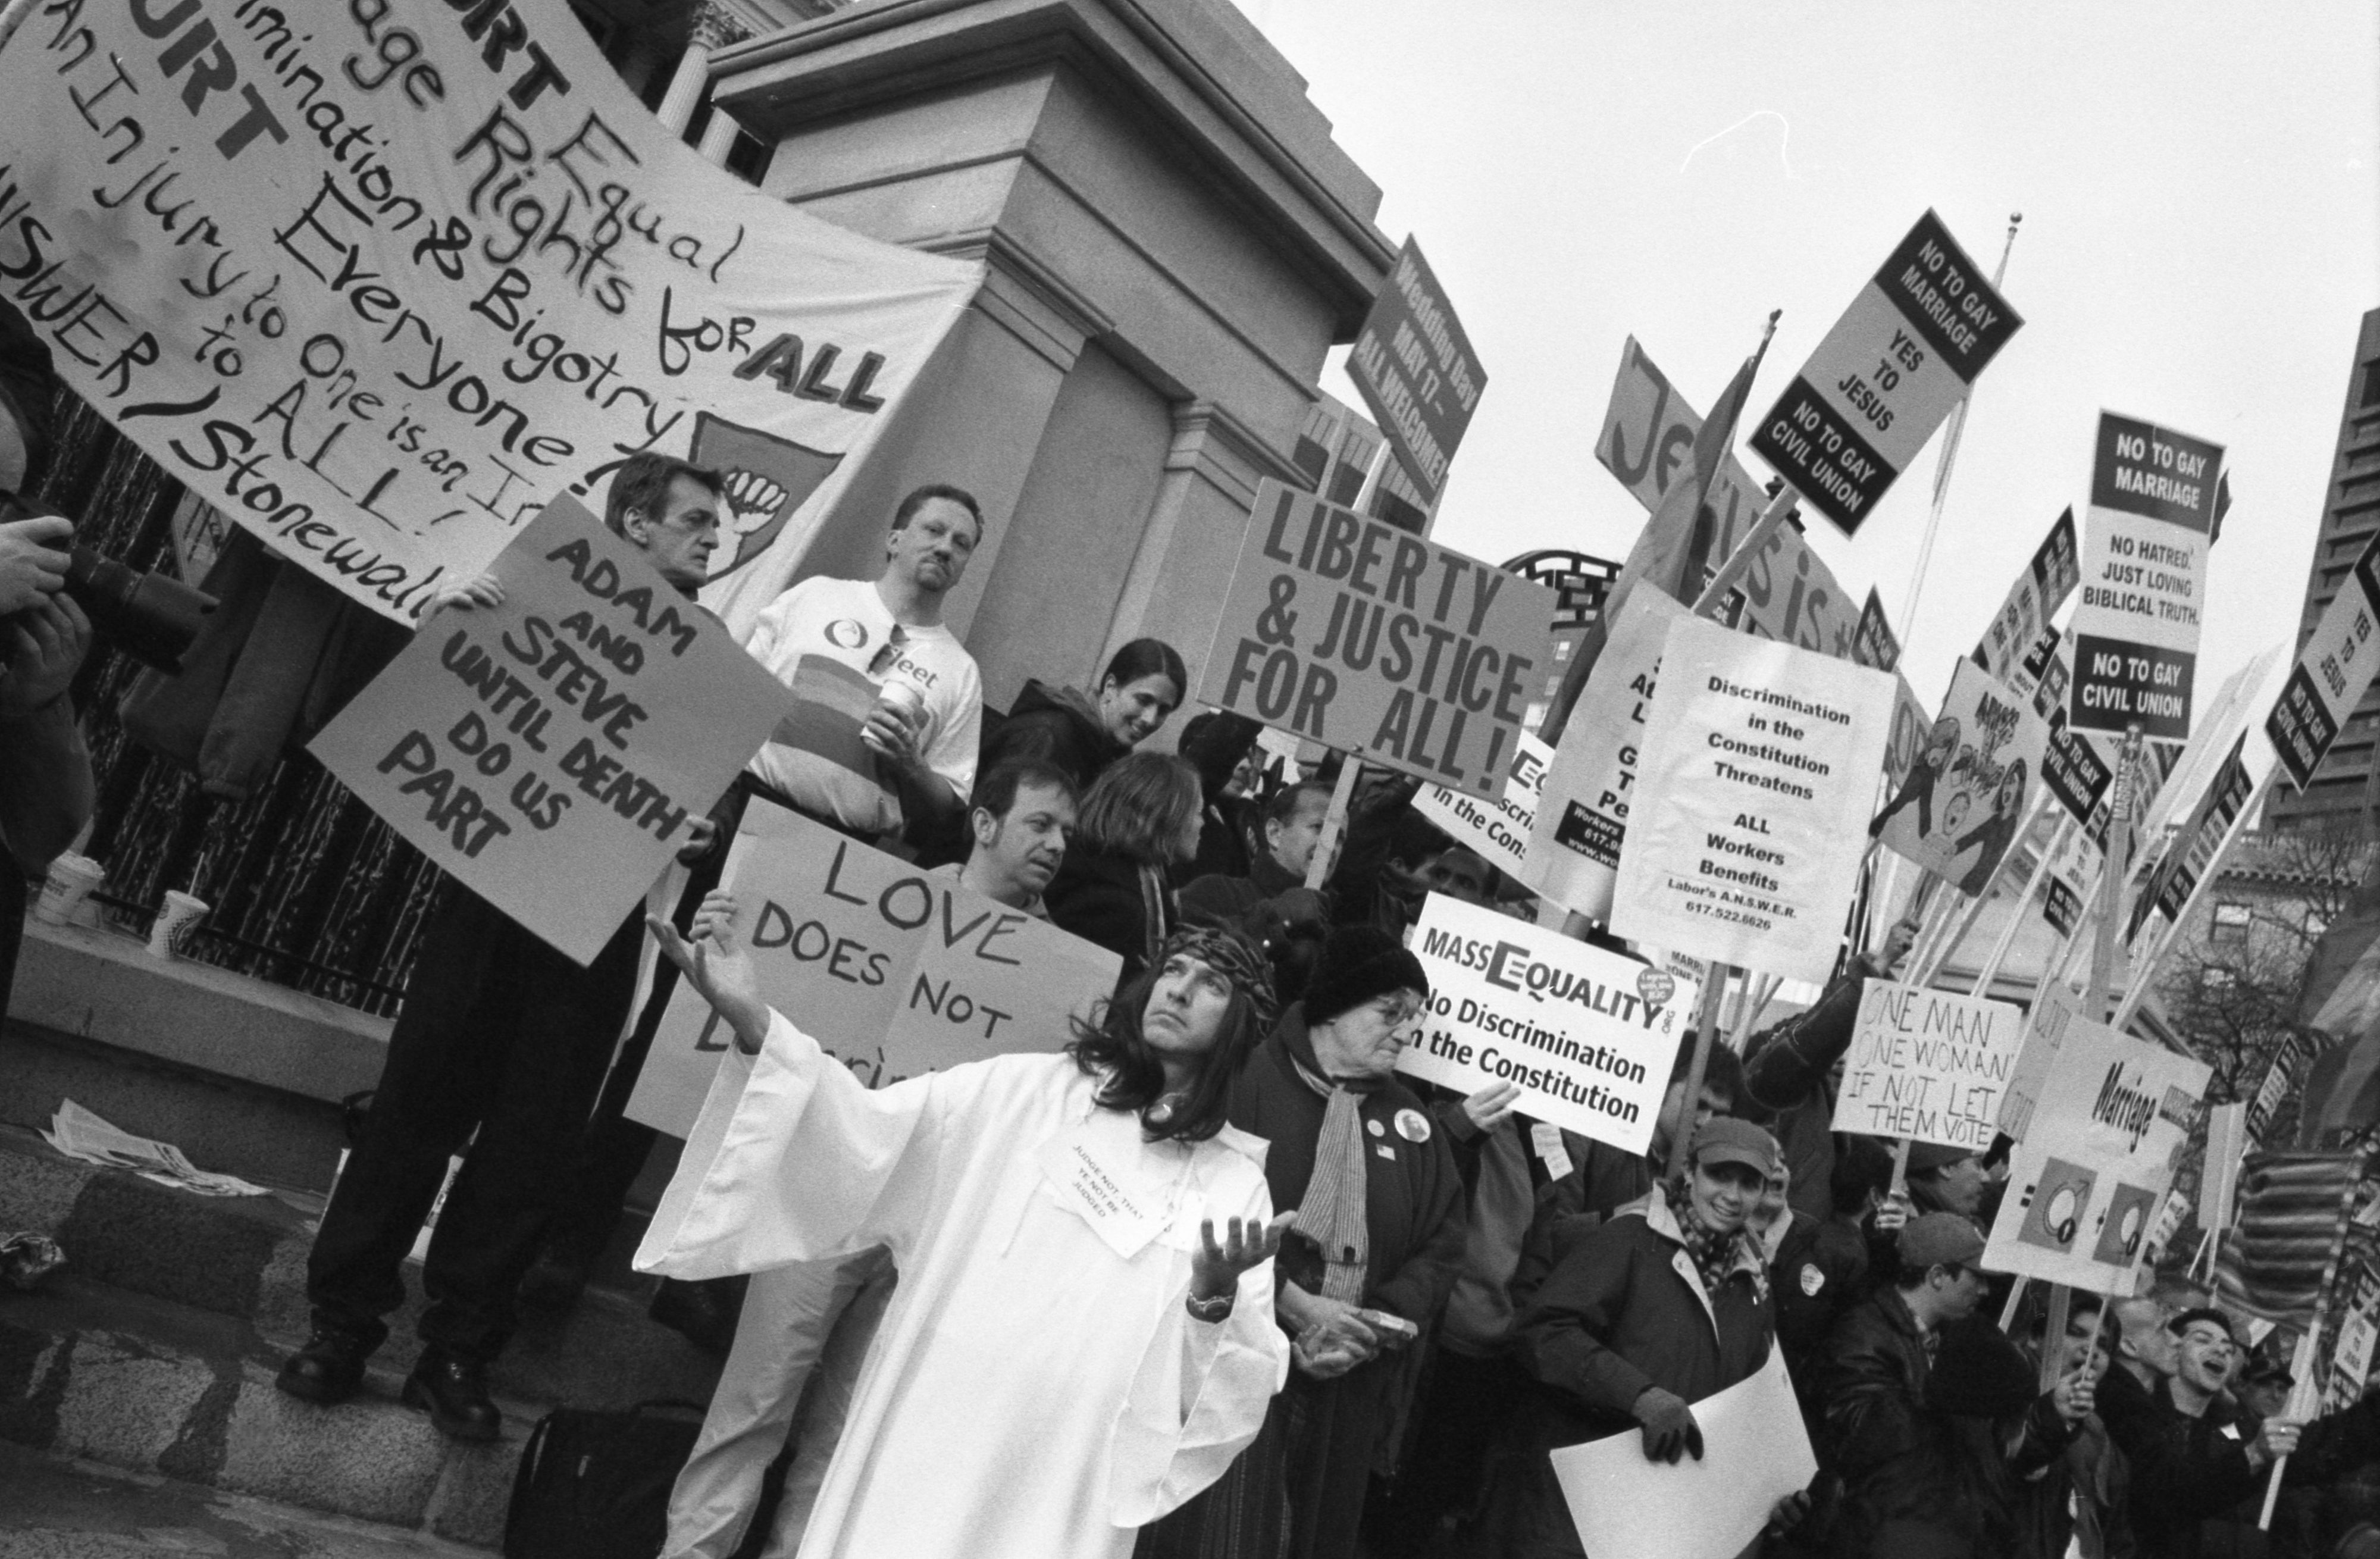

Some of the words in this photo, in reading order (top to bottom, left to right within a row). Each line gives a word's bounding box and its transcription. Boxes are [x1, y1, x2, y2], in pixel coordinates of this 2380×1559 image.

[549, 110, 745, 284] Equal
[58, 52, 249, 298] Injury
[243, 274, 286, 339] to
[299, 333, 384, 421] One
[387, 403, 426, 452] is
[419, 447, 468, 493] an
[454, 101, 634, 315] Rights
[733, 333, 887, 415] ALL
[1918, 239, 1945, 272] NO
[1941, 267, 1965, 298] TO
[1962, 292, 1998, 331] GAY
[414, 216, 472, 280] &
[469, 269, 684, 453] Bigotry
[1396, 254, 1457, 372] Wedding
[1449, 355, 1477, 412] Day
[1900, 265, 1978, 355] MARRIAGE
[195, 314, 243, 377] to
[1391, 320, 1428, 380] MAY
[1887, 328, 1925, 372] YES
[1838, 373, 1894, 432] JESUS
[1873, 358, 1900, 392] TO
[1771, 421, 1811, 467] CIVIL
[1811, 456, 1864, 514] UNION
[1792, 400, 1821, 433] NO
[1818, 424, 1841, 454] TO
[1840, 447, 1877, 485] GAY
[2115, 433, 2145, 461] NO
[2152, 442, 2174, 469] TO
[2177, 449, 2207, 480] GAY
[2115, 465, 2202, 511] MARRIAGE
[1263, 489, 1504, 637] LIBERTY
[2110, 534, 2134, 556] NO
[546, 539, 697, 658] ADAM
[2083, 586, 2153, 616] BIBLICAL
[2102, 562, 2144, 586] JUST
[2147, 571, 2193, 597] LOVING
[559, 610, 644, 675] AND
[1255, 574, 1298, 648] &
[1313, 590, 1533, 725] JUSTICE
[2092, 652, 2121, 677] NO
[2127, 656, 2149, 682] TO
[2153, 662, 2182, 687] GAY
[503, 616, 649, 751] STEVE
[1708, 676, 1851, 726] Discrimination
[2082, 683, 2131, 712] CIVIL
[2136, 690, 2184, 719] UNION
[441, 630, 553, 754] UNTIL
[559, 737, 688, 842] DEATH
[1221, 637, 1338, 738] FOR
[1370, 686, 1506, 792] ALL!
[1748, 714, 1768, 731] in
[1773, 720, 1805, 740] the
[447, 710, 512, 777] DO
[510, 772, 572, 831] US
[1708, 732, 1830, 776] Constitution
[2055, 724, 2072, 749] NO
[2069, 741, 2083, 765] TO
[376, 730, 512, 859] PART
[1714, 761, 1814, 800] Threatens
[2063, 768, 2093, 809] UNION
[1454, 798, 1486, 829] the
[1573, 806, 1619, 836] Workers
[1734, 813, 1771, 834] ALL
[1699, 859, 1778, 892] Benefits
[1706, 833, 1785, 866] Workers
[823, 840, 1028, 965] LOVE
[1668, 878, 1717, 899] Labor's
[753, 900, 891, 986] DOES
[909, 972, 1013, 1040] NOT
[1457, 998, 1646, 1084] Discrimination
[1861, 986, 1918, 1032] ONE
[1923, 998, 1993, 1048] MAN
[1429, 1029, 1473, 1066] the
[1479, 1047, 1640, 1123] Constitution
[1858, 1031, 1908, 1068] ONE
[1914, 1038, 2009, 1082] WOMAN
[1848, 1072, 1875, 1098] IF
[1883, 1074, 1937, 1107] NOT
[1947, 1082, 1997, 1120] LET
[1867, 1104, 1936, 1138] THEM
[1944, 1117, 1992, 1145] VOTE
[1073, 1145, 1102, 1176] JUDGE
[1089, 1181, 1108, 1200] NOT
